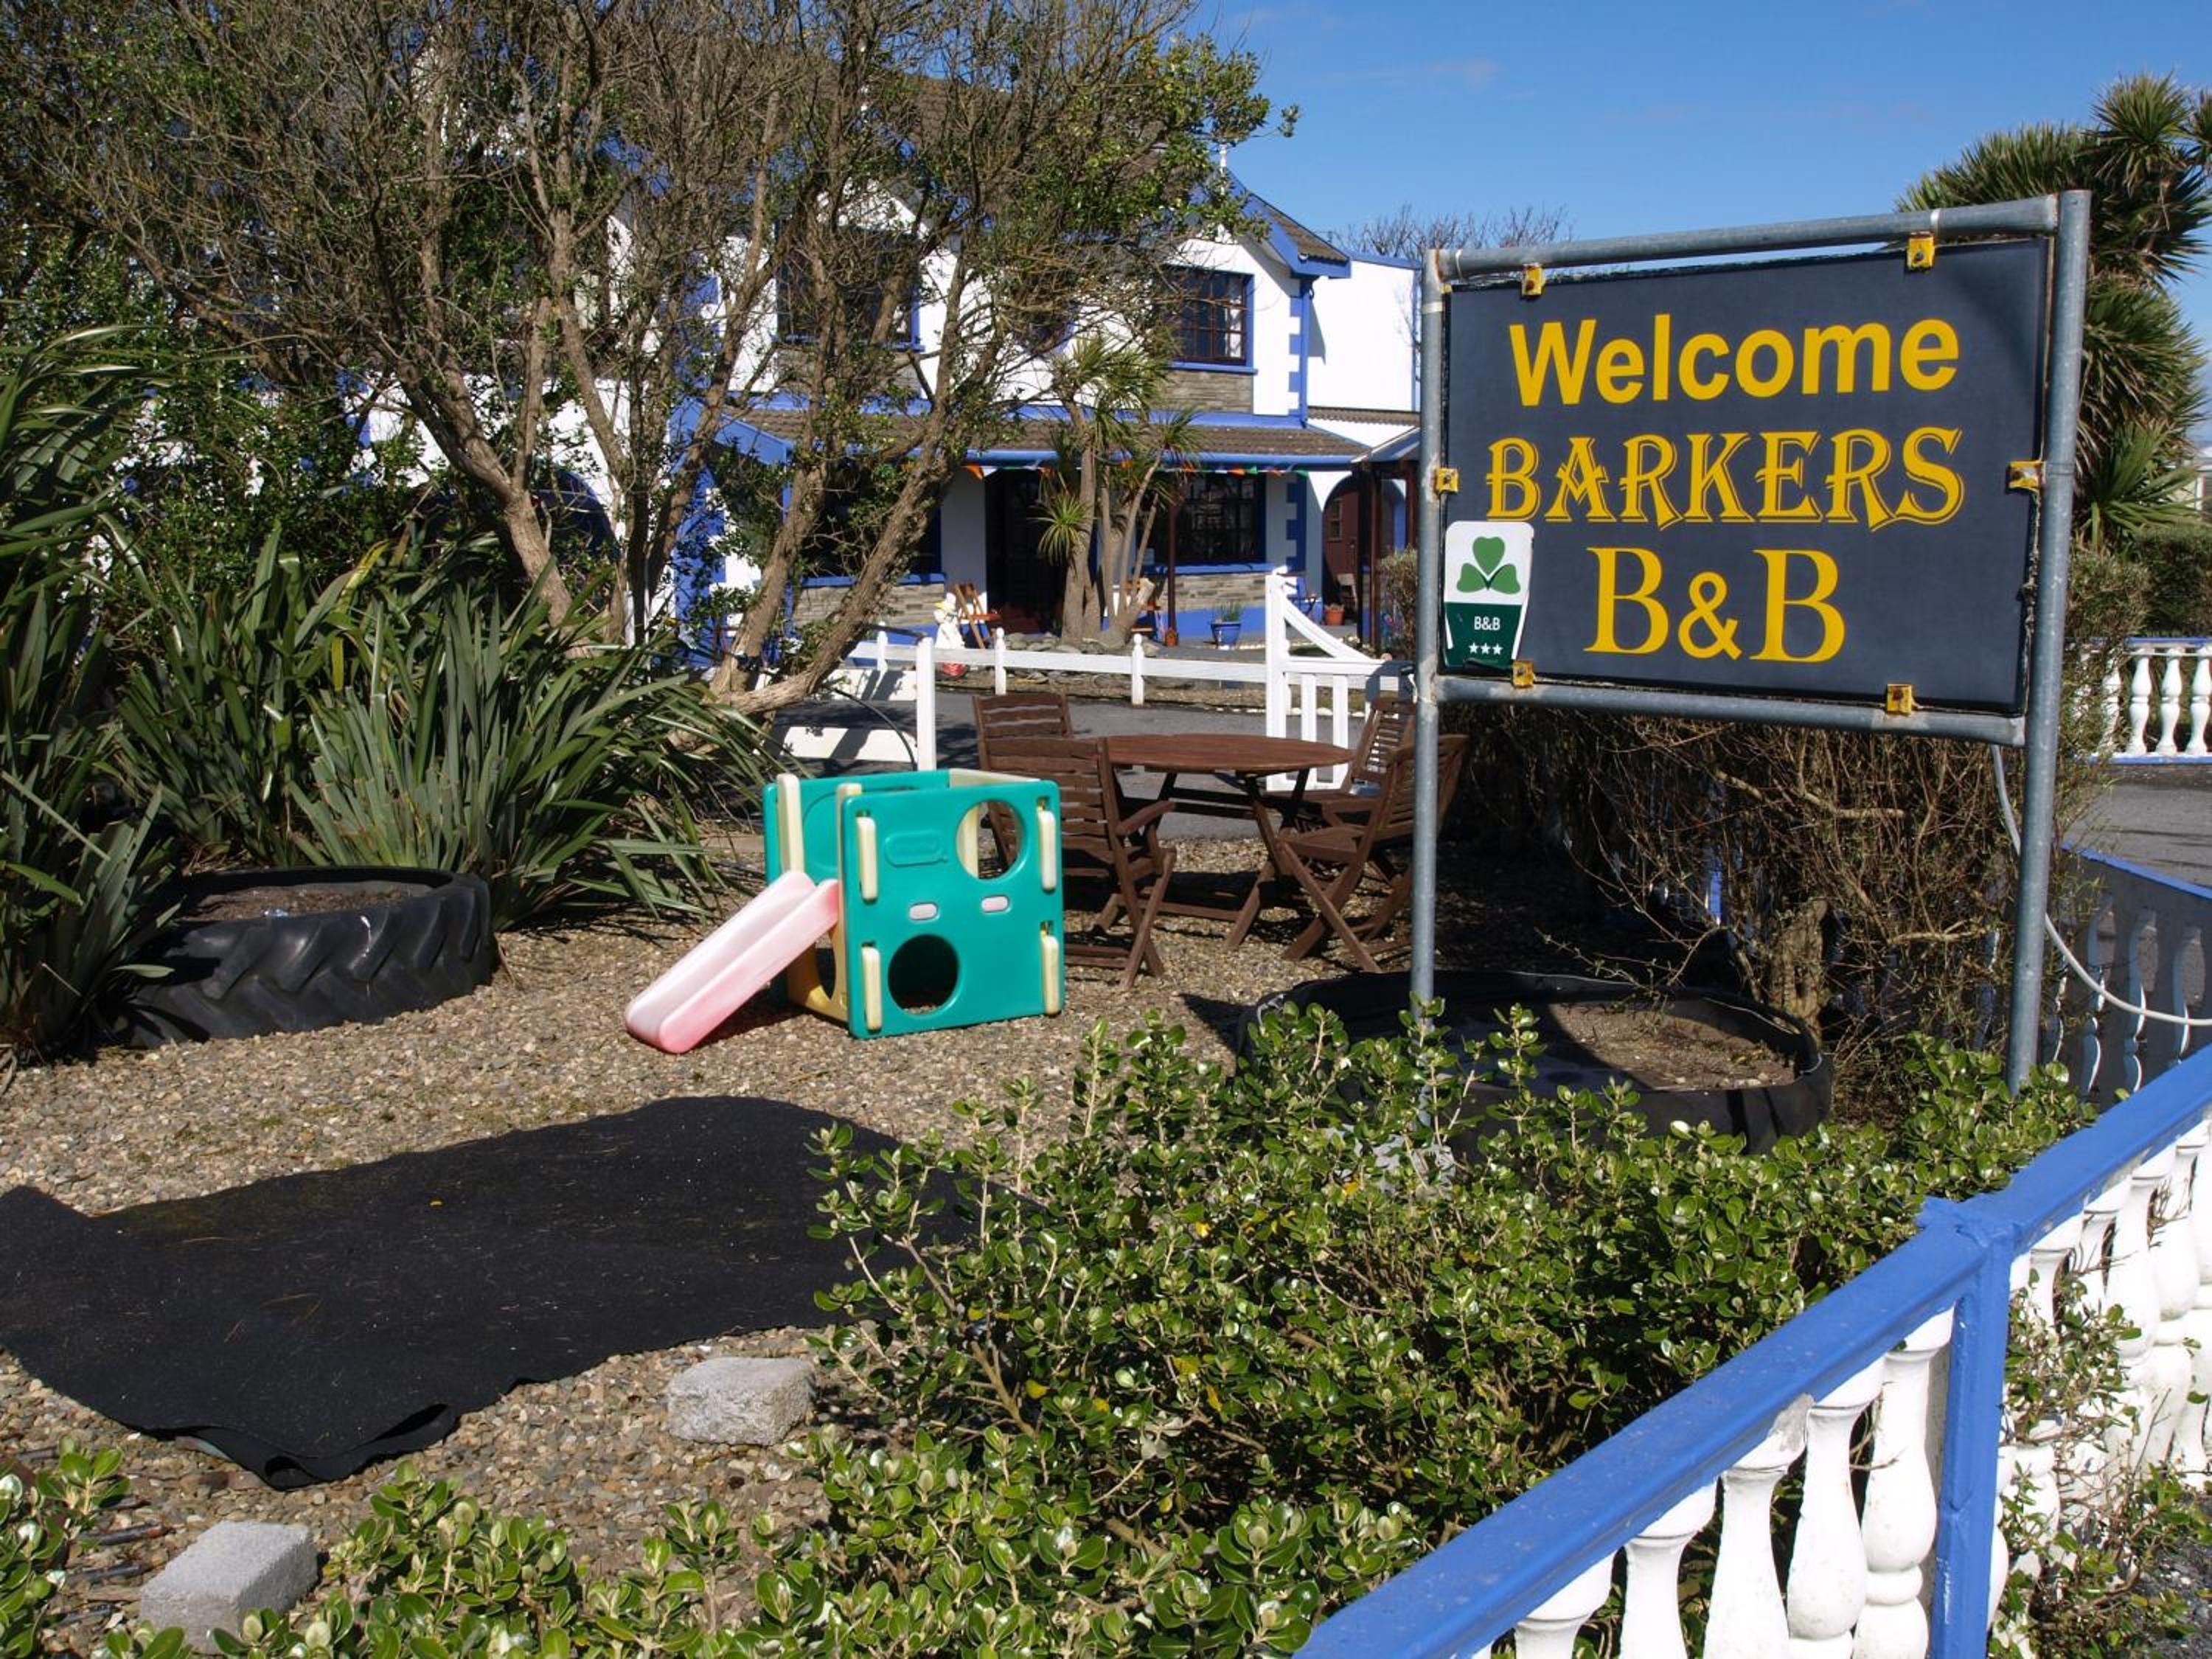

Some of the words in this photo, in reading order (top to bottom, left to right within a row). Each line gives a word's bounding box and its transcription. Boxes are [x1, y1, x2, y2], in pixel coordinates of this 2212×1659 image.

[1509, 313, 1960, 406] Welcome
[1486, 426, 1965, 531] BARKERS
[1474, 616, 1501, 631] B&B
[1584, 546, 1846, 664] B&B
